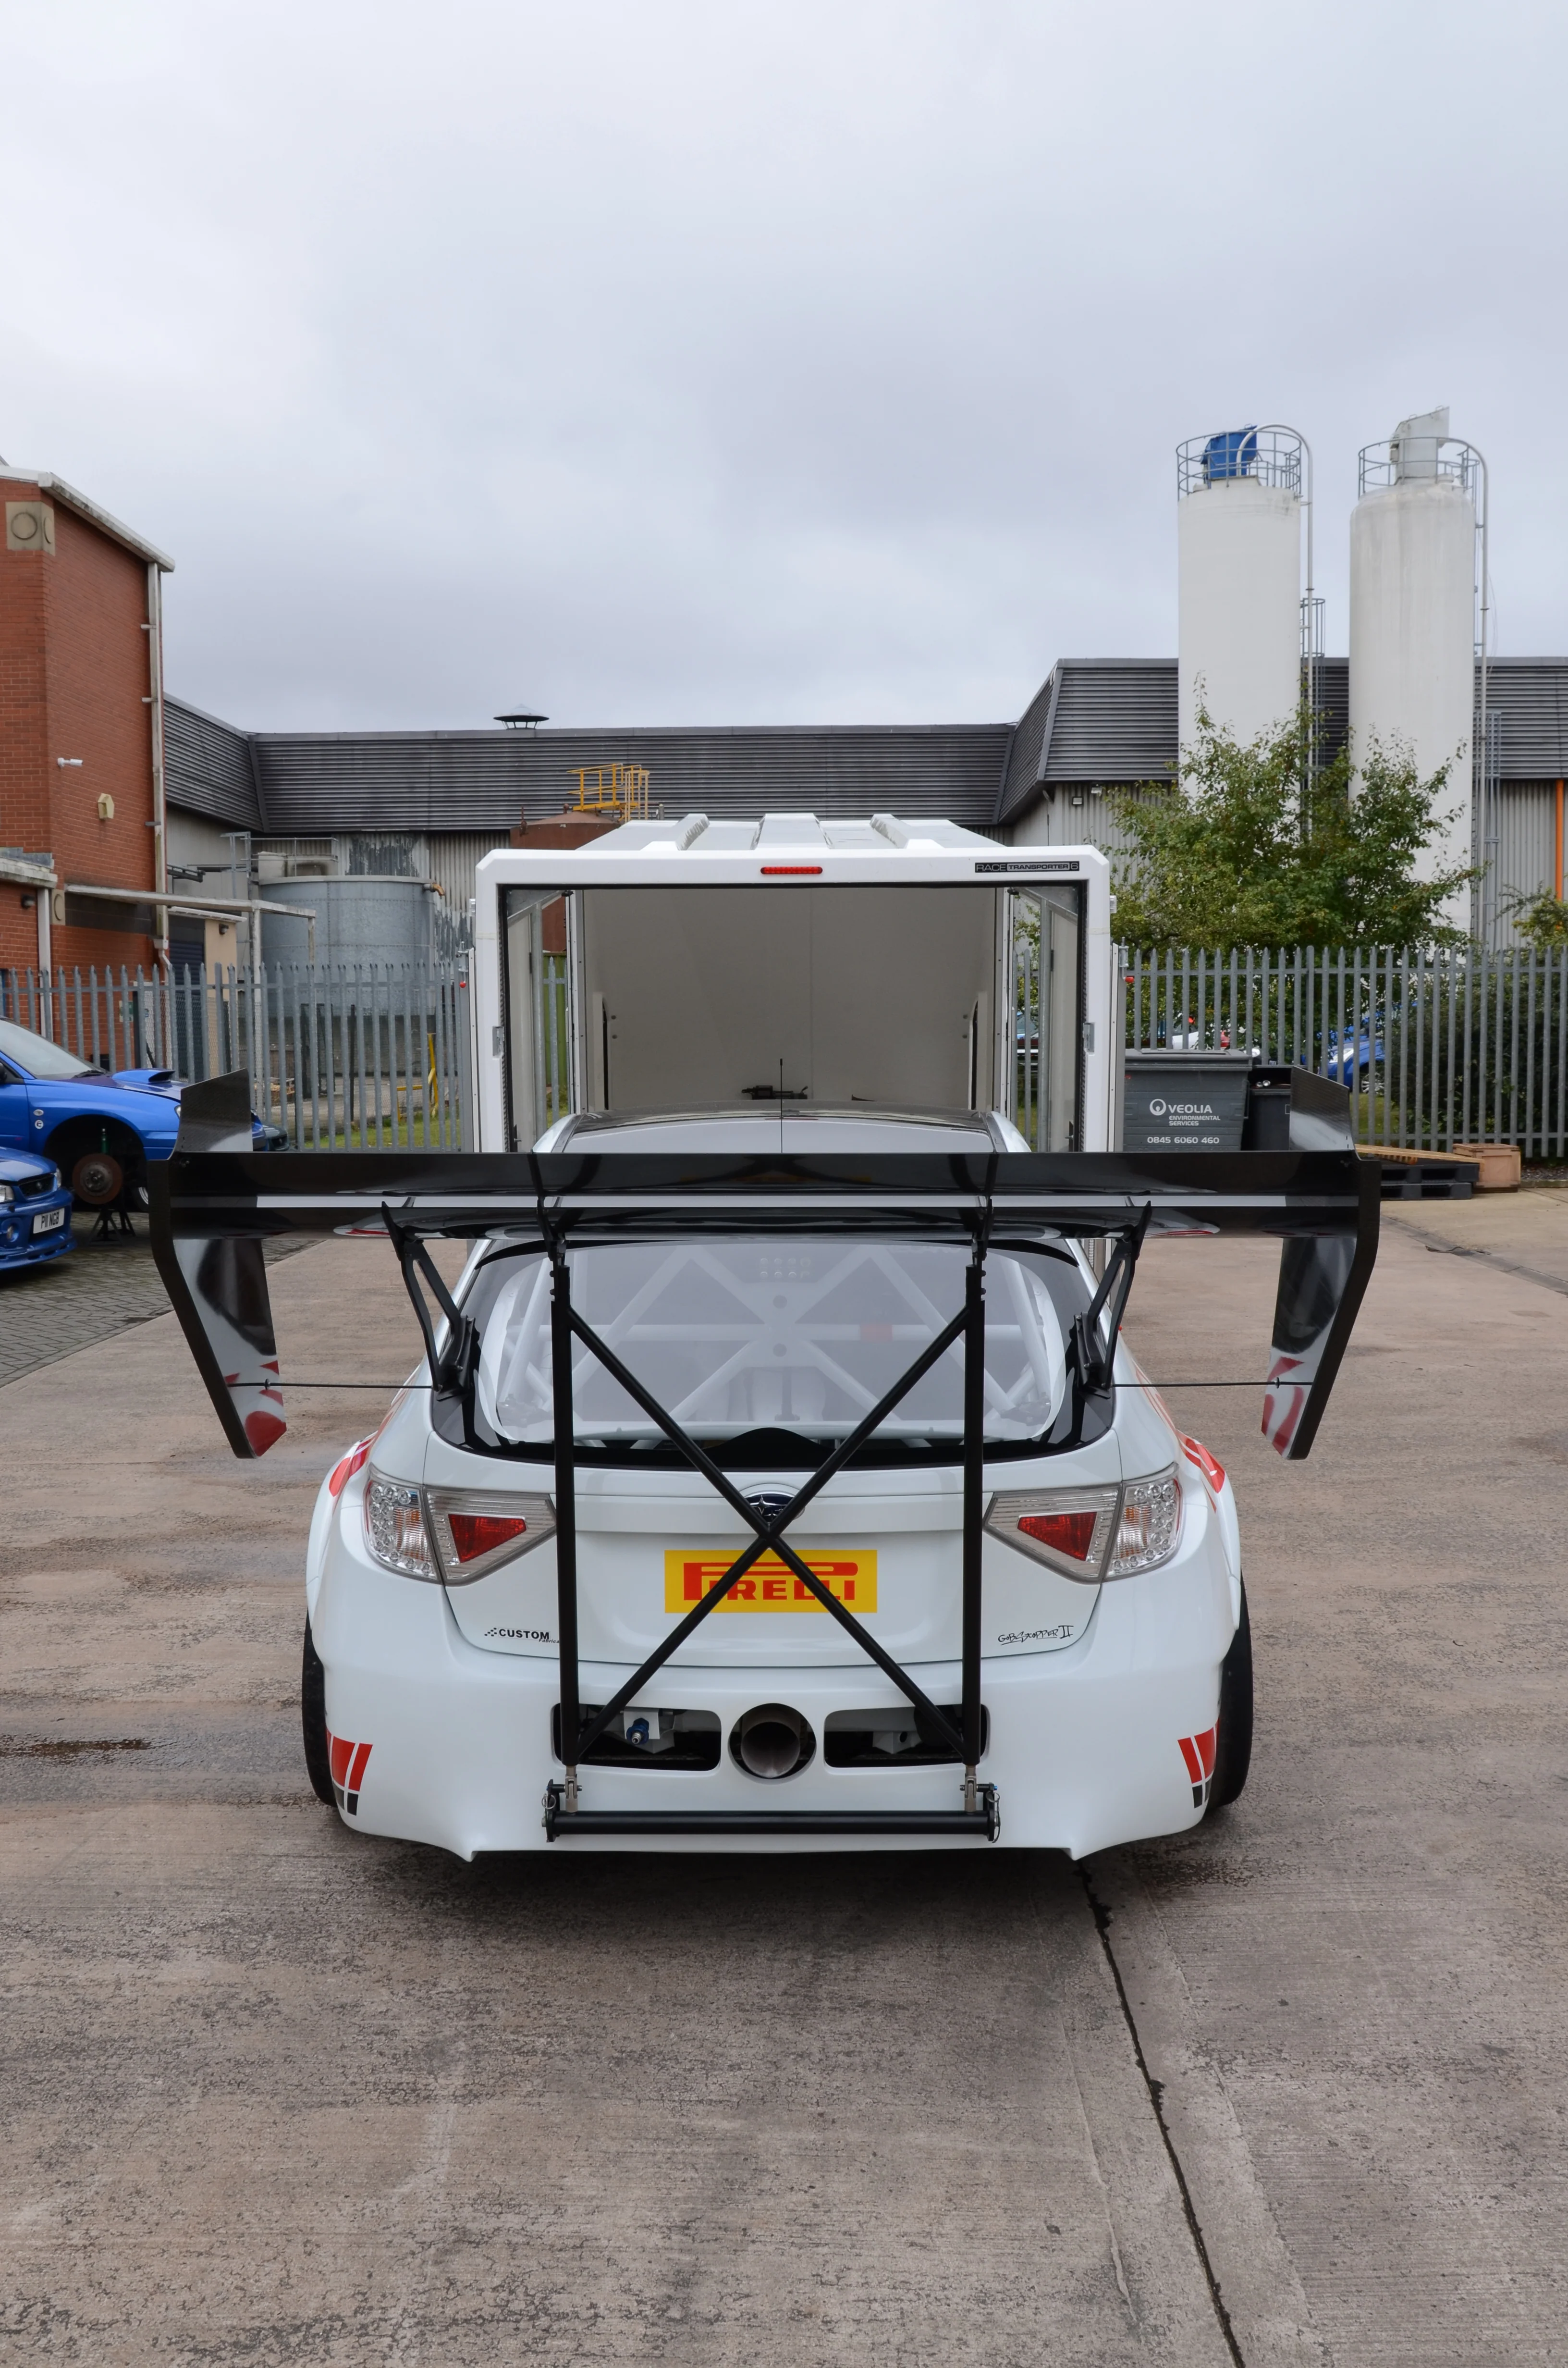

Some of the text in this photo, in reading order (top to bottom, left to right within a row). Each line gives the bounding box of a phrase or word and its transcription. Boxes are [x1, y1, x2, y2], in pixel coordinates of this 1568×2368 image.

[1168, 1104, 1213, 1114] VEOLIA
[683, 1562, 858, 1601] PRELI
[499, 1628, 550, 1640] CUSTOM
